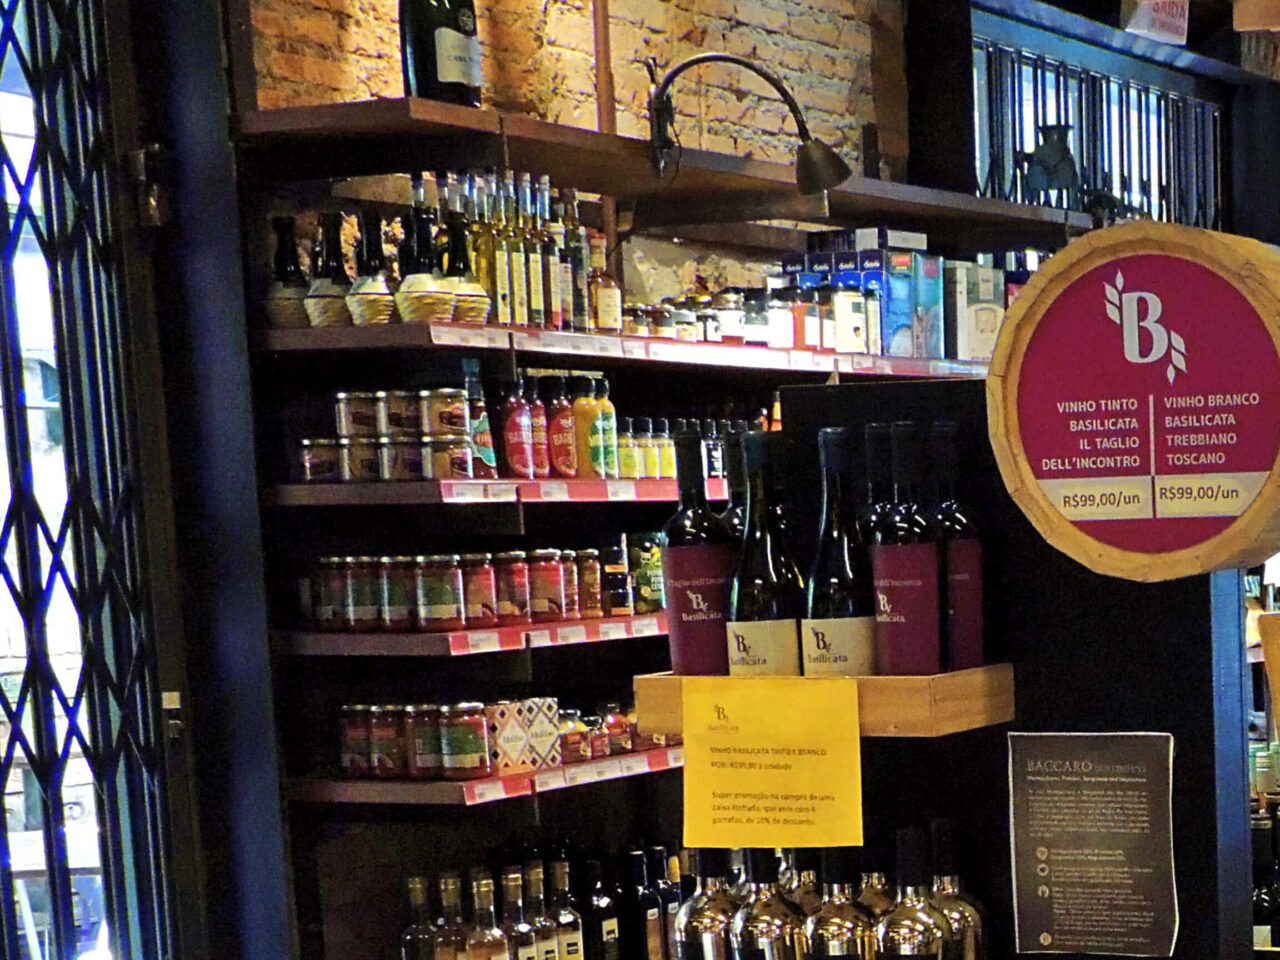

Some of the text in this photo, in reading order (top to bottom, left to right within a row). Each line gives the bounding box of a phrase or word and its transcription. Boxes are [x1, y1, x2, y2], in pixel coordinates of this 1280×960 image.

[1122, 291, 1169, 363] B
[1057, 398, 1138, 412] VINHO TINTO
[1164, 393, 1259, 408] VINHO BRANCO
[1069, 418, 1138, 431] BASILICATA
[1165, 414, 1236, 427] BASILICATA
[1079, 437, 1140, 450] IL TAGLIO
[1166, 433, 1237, 446] TREBBIANO
[1166, 452, 1225, 465] TOSCANO
[1062, 492, 1140, 508] R$99,00/un
[1159, 486, 1239, 502] R$99,00/un
[1027, 760, 1092, 773] BACCARO
